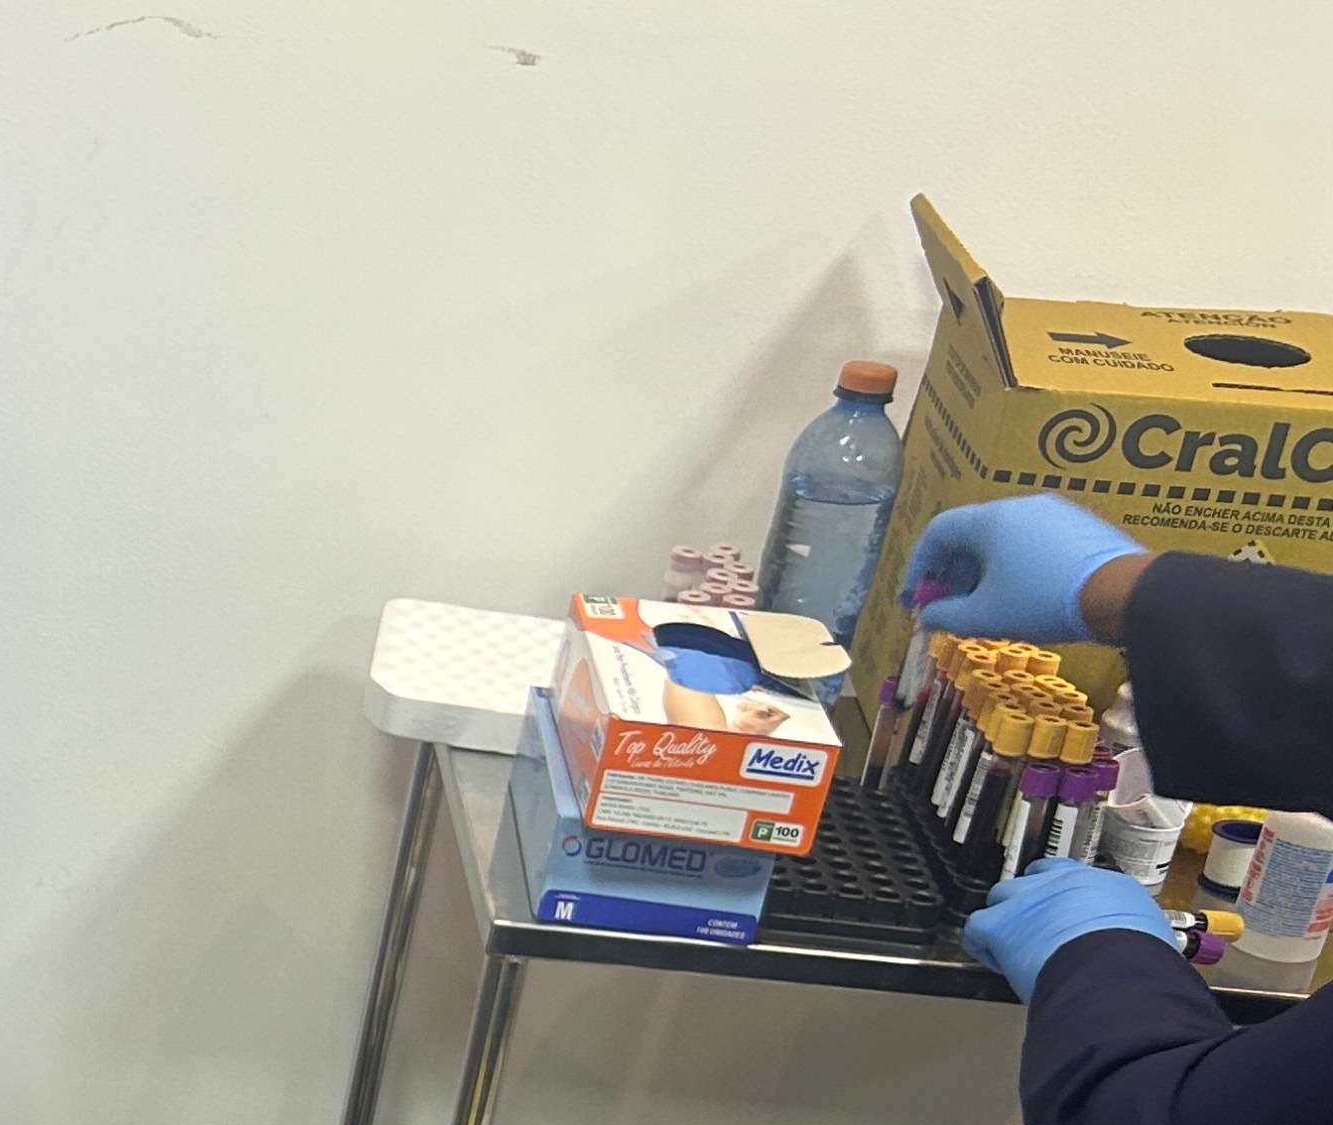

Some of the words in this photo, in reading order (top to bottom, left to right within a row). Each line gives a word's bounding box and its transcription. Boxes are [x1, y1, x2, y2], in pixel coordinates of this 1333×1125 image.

[1048, 355, 1090, 365] COM
[1093, 359, 1175, 371] CUIDADO
[1058, 347, 1151, 361] MANUSEIE
[1123, 514, 1229, 533] RECOMENDA-SE
[1232, 522, 1242, 533] O
[1245, 523, 1318, 540] DESCARTE
[1152, 502, 1182, 515] NÃO
[1185, 505, 1240, 521] ENCHER
[1243, 511, 1284, 524] ACIMA
[1287, 514, 1331, 528] DESTA
[614, 731, 646, 762] Top
[653, 731, 718, 765] Quality
[748, 748, 820, 775] Medix
[757, 827, 768, 838] P
[775, 826, 799, 838] 100
[586, 837, 706, 872] GLOMED
[554, 901, 575, 921] M
